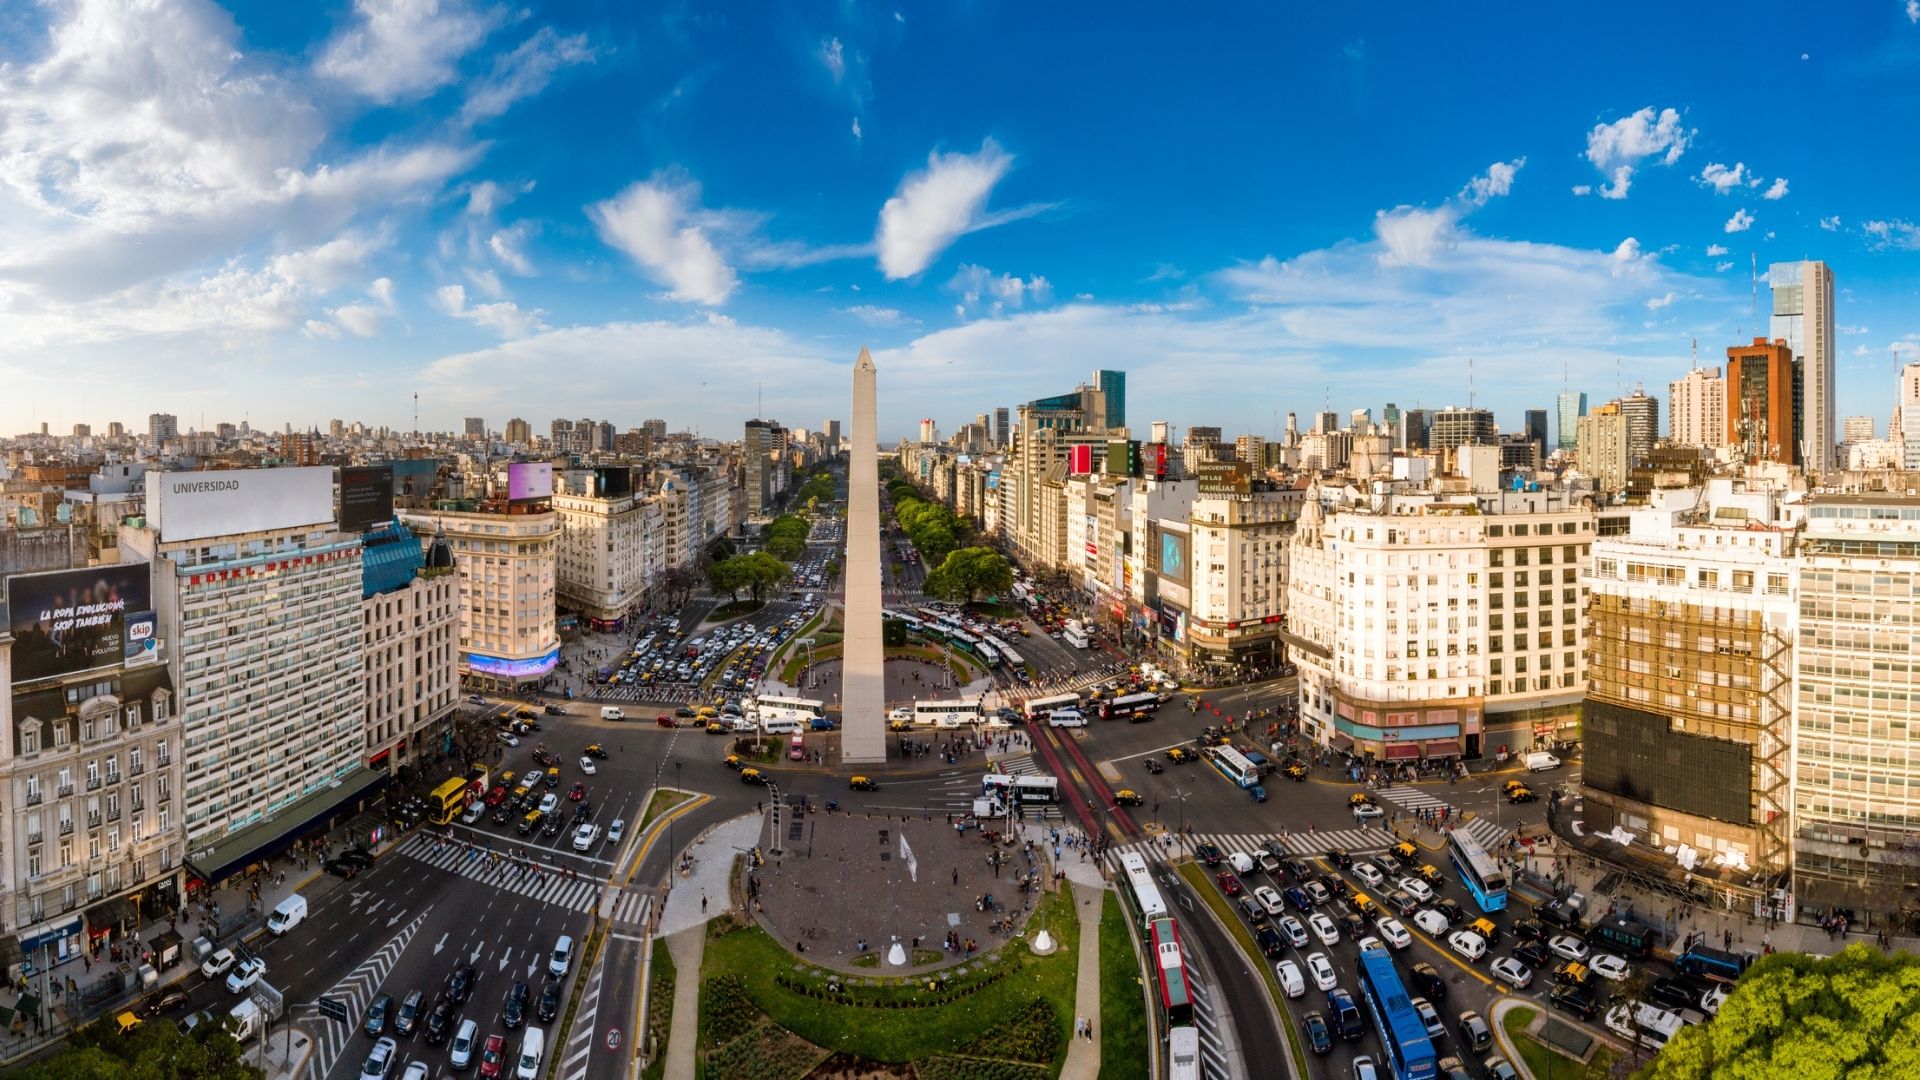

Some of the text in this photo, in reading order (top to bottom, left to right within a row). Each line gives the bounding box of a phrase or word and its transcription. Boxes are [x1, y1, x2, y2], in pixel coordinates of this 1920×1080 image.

[173, 480, 239, 493] UNIVERSIDAD
[190, 567, 255, 586] HOTEL
[40, 610, 51, 621] LA
[53, 607, 74, 619] ROPA
[53, 619, 74, 631] SKIP
[132, 624, 150, 636] skip
[92, 646, 120, 656] EVOLUTION
[608, 1032, 619, 1045] 20
